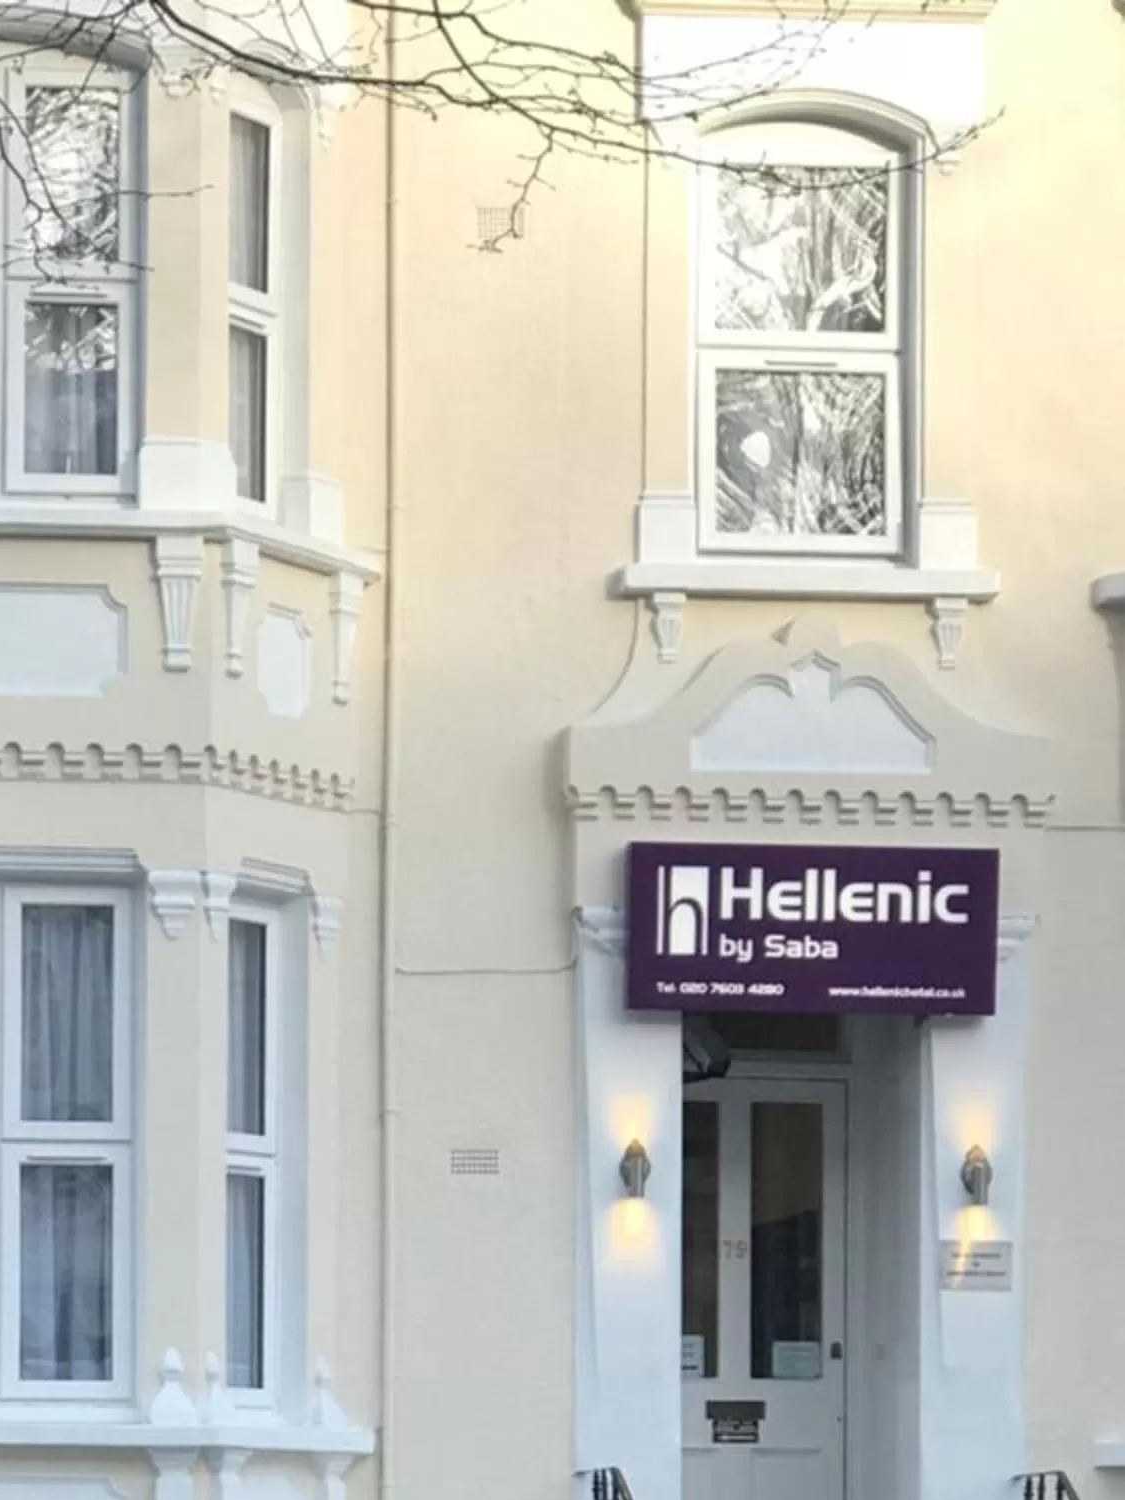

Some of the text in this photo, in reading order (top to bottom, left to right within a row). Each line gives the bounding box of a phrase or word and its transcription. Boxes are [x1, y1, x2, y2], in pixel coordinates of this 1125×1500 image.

[719, 866, 969, 924] Hellenic
[718, 933, 839, 963] by Saba
[679, 981, 709, 995] 020
